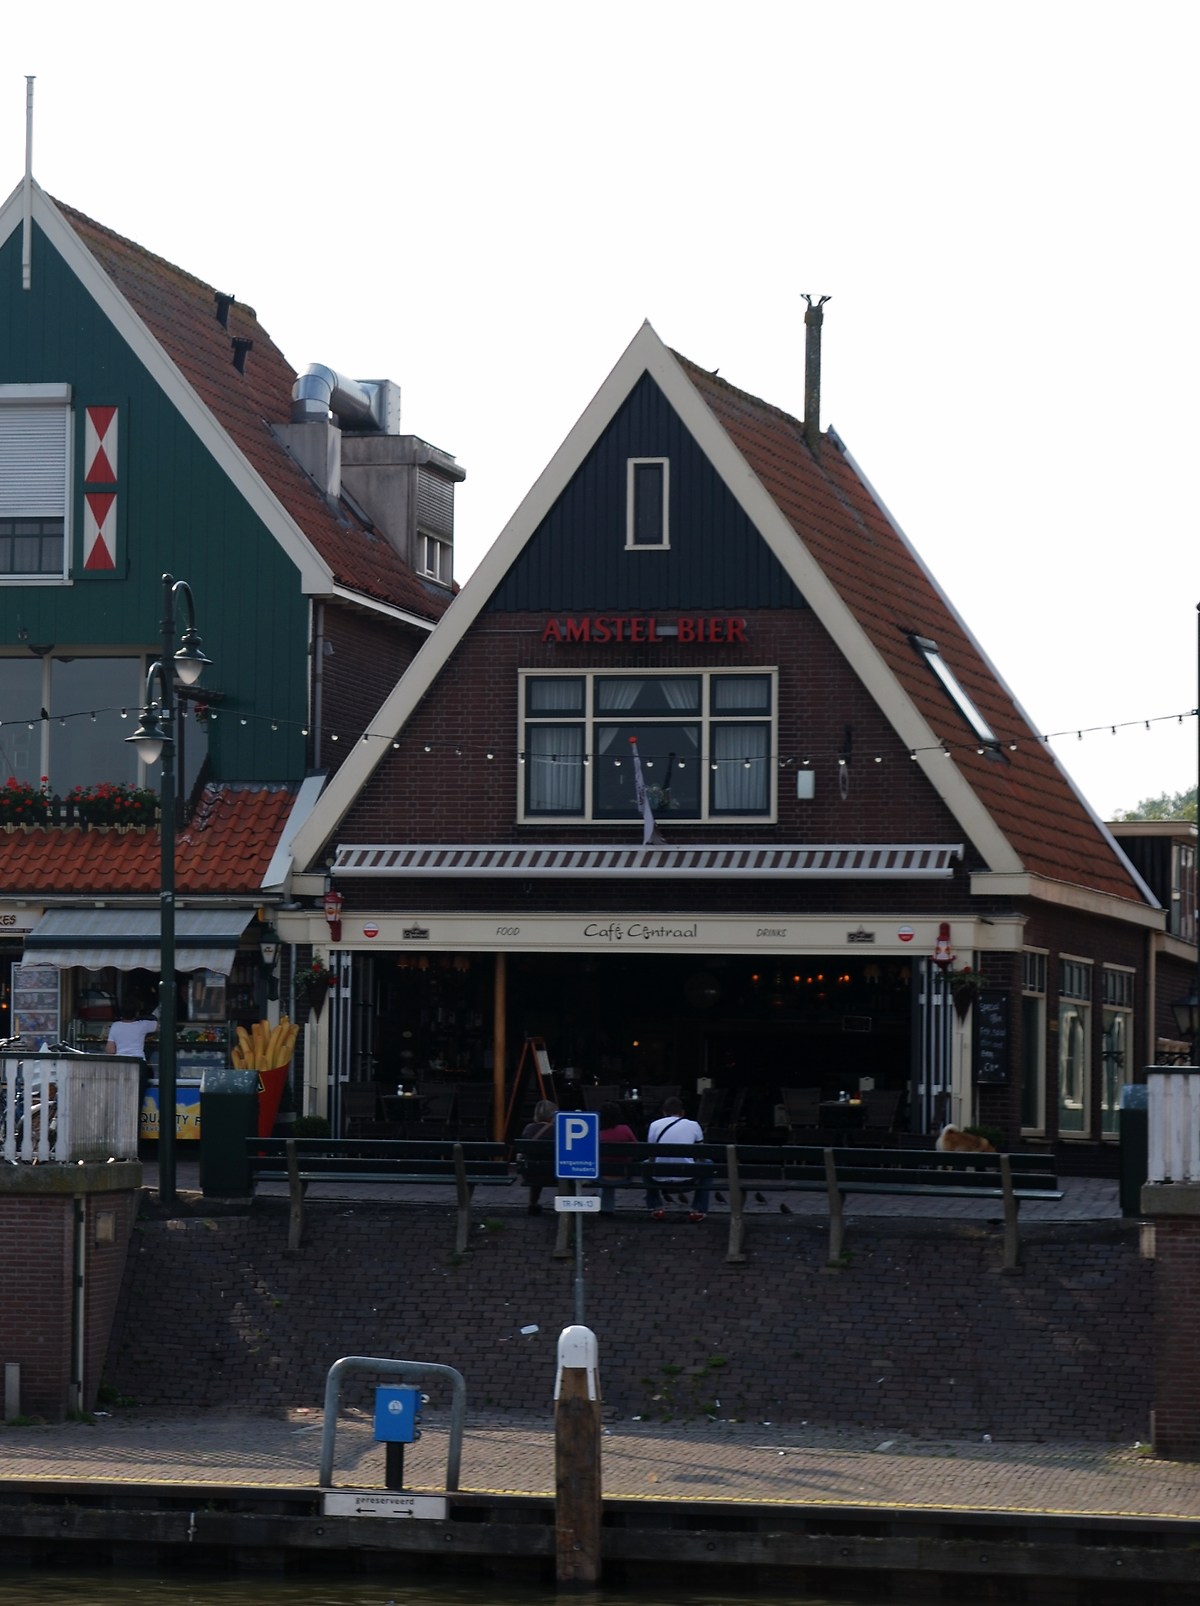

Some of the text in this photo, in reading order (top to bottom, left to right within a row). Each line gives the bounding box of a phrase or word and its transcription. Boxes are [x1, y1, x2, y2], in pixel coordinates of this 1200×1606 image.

[542, 617, 749, 643] AMSTEL BIER
[496, 926, 520, 937] FOOD
[583, 922, 697, 942] Café Centraal
[140, 1112, 189, 1125] QUTY
[565, 1118, 589, 1151] P
[355, 1496, 415, 1506] gereserveerd
